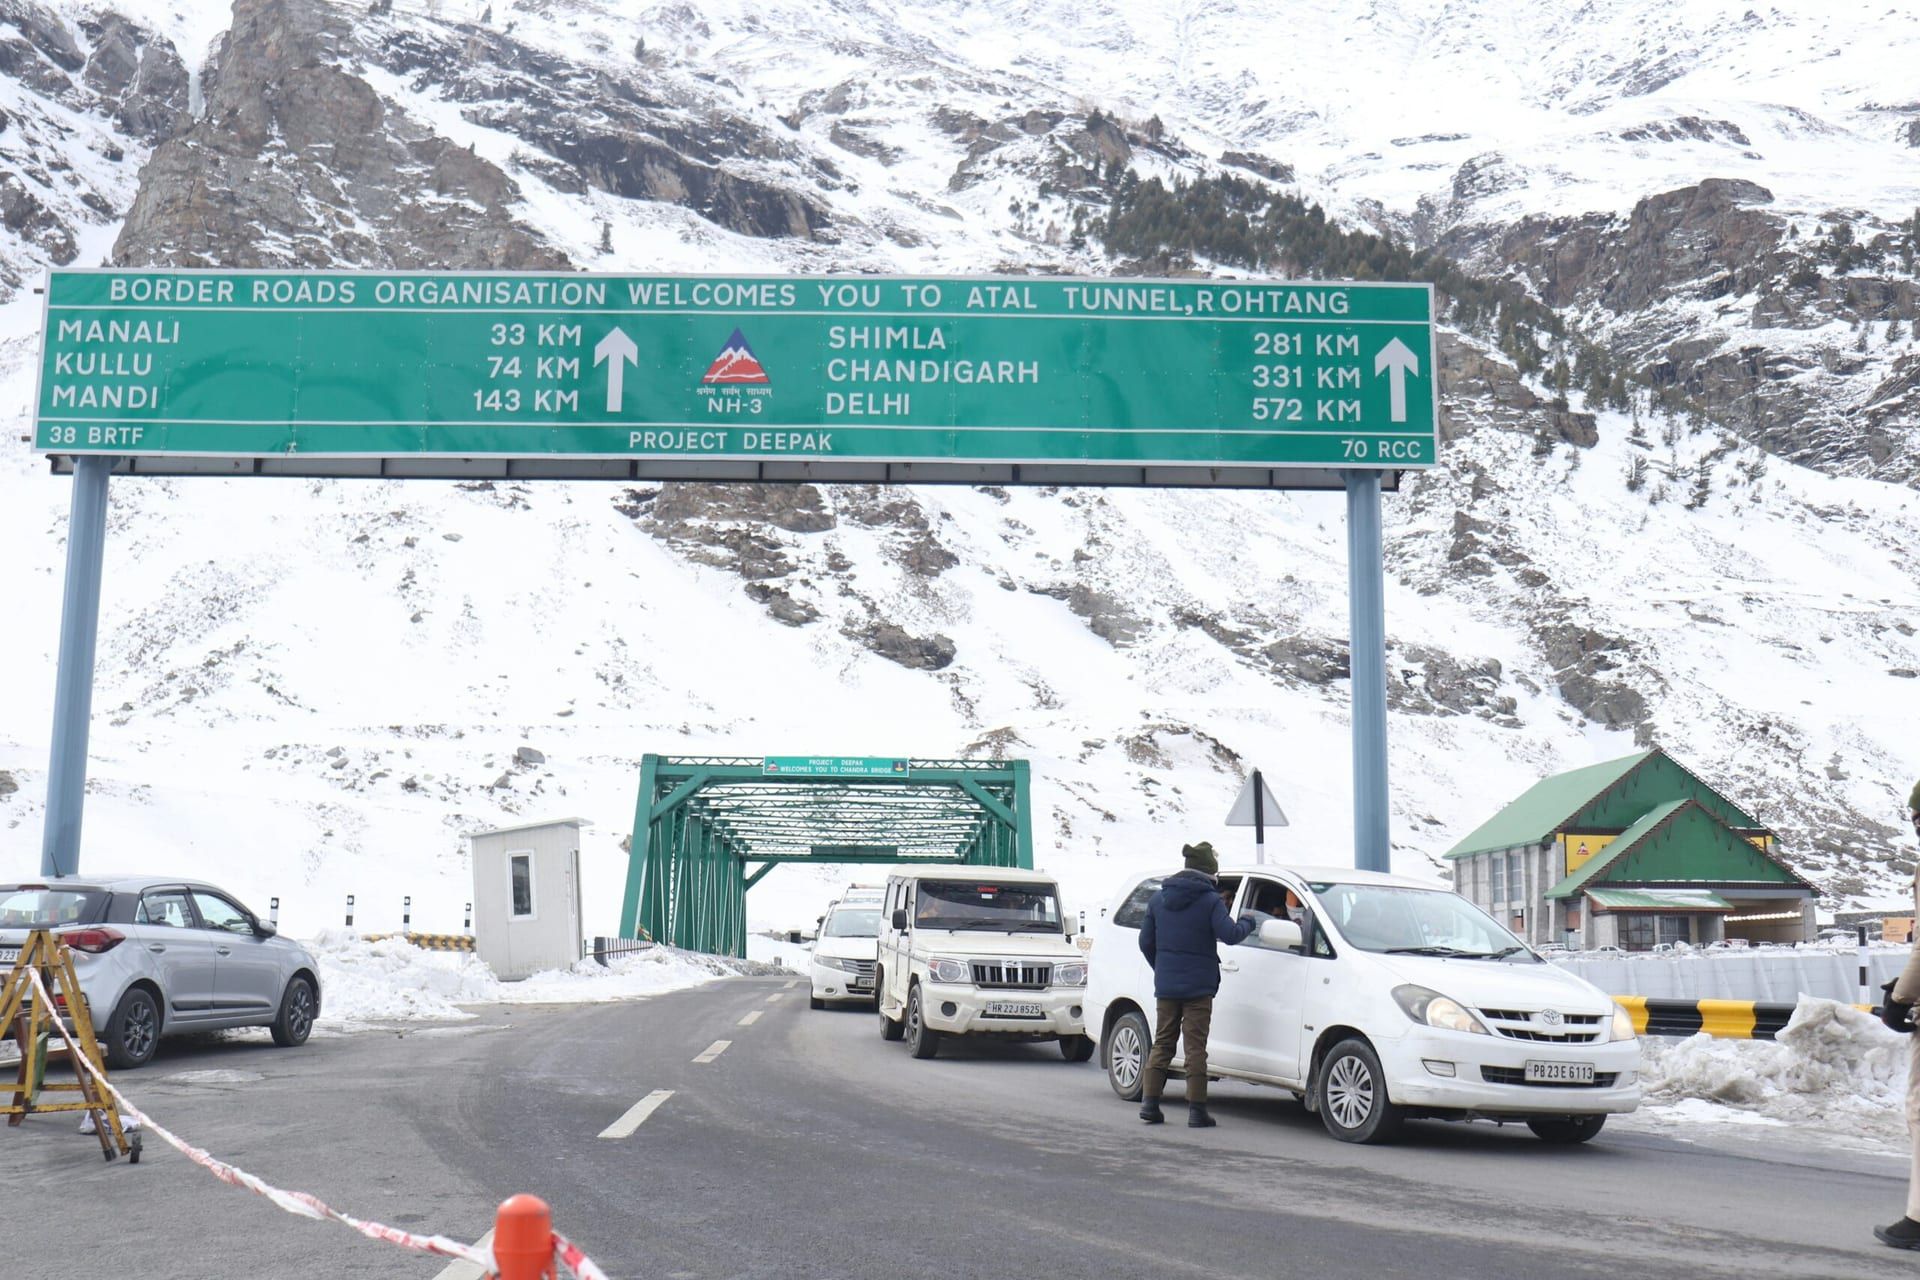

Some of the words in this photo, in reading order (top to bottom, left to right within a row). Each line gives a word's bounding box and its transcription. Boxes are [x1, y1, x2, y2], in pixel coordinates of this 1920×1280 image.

[110, 278, 234, 303] BORDER
[252, 279, 356, 304] ROADS
[374, 280, 606, 306] ORGANISATION
[628, 282, 796, 307] WELCOMES
[817, 283, 881, 308] YOU
[900, 284, 942, 308] TO
[966, 286, 1038, 309] ATAL
[57, 319, 180, 344] MANALI
[490, 323, 526, 346] 33
[537, 323, 582, 347] KM
[828, 325, 946, 350] SHIMLA
[1253, 332, 1302, 355] 281
[1315, 334, 1360, 356] KM
[55, 352, 152, 377] KULLU
[486, 356, 523, 379] 74
[536, 356, 580, 379] KM
[827, 358, 1039, 384] CHANDIGARH
[1252, 364, 1302, 388] 331
[1317, 367, 1361, 389] KM
[51, 384, 158, 409] MANDI
[473, 388, 521, 412] 143
[534, 389, 579, 412] KM
[708, 397, 762, 414] NH-3
[826, 392, 910, 415] DELHI
[1252, 397, 1303, 421] 572
[1317, 399, 1361, 422] KM
[49, 425, 77, 444] 38
[87, 426, 144, 445] BRTF
[629, 431, 728, 451] PROJECT
[742, 432, 832, 451] DEEPAK
[1341, 440, 1368, 458] 70
[1378, 440, 1421, 459] RCC
